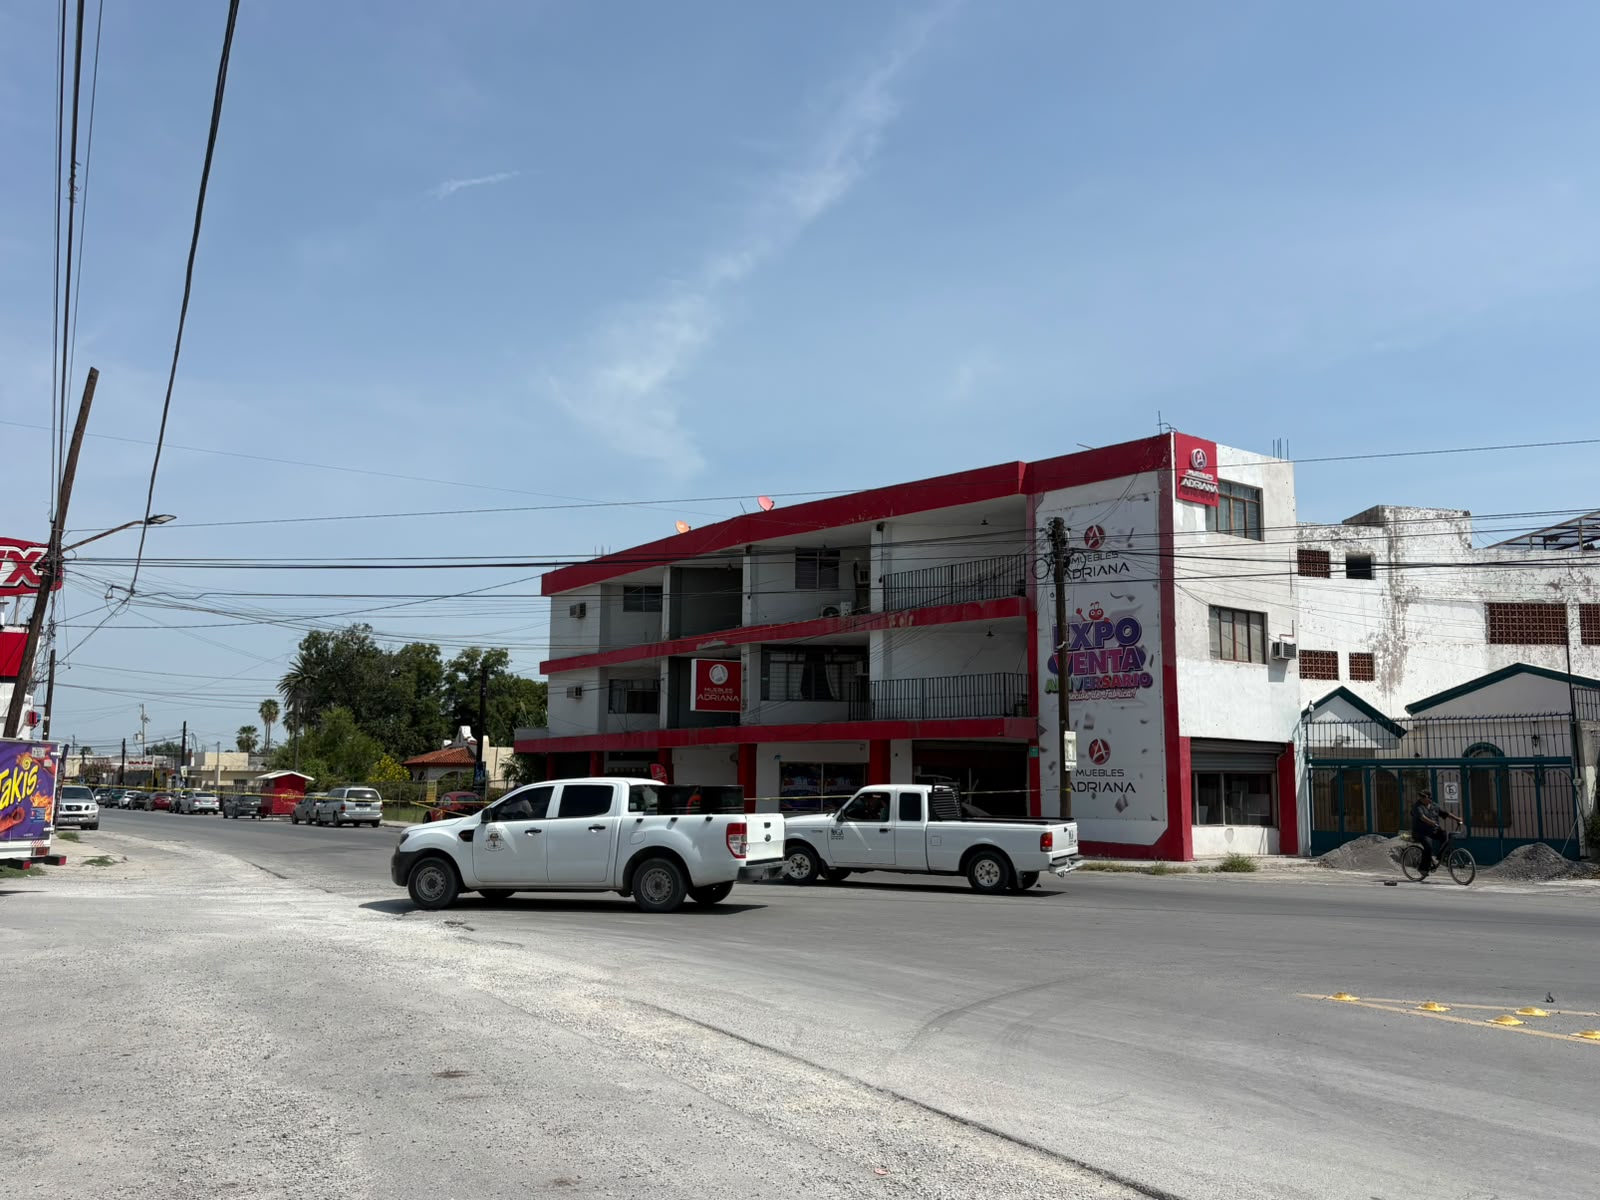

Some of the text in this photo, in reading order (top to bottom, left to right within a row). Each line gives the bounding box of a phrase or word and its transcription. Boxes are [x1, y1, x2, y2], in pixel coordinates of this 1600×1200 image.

[1180, 478, 1219, 493] ADRIANA
[697, 694, 739, 702] ADRIANA
[1075, 769, 1125, 777] MUEBLES
